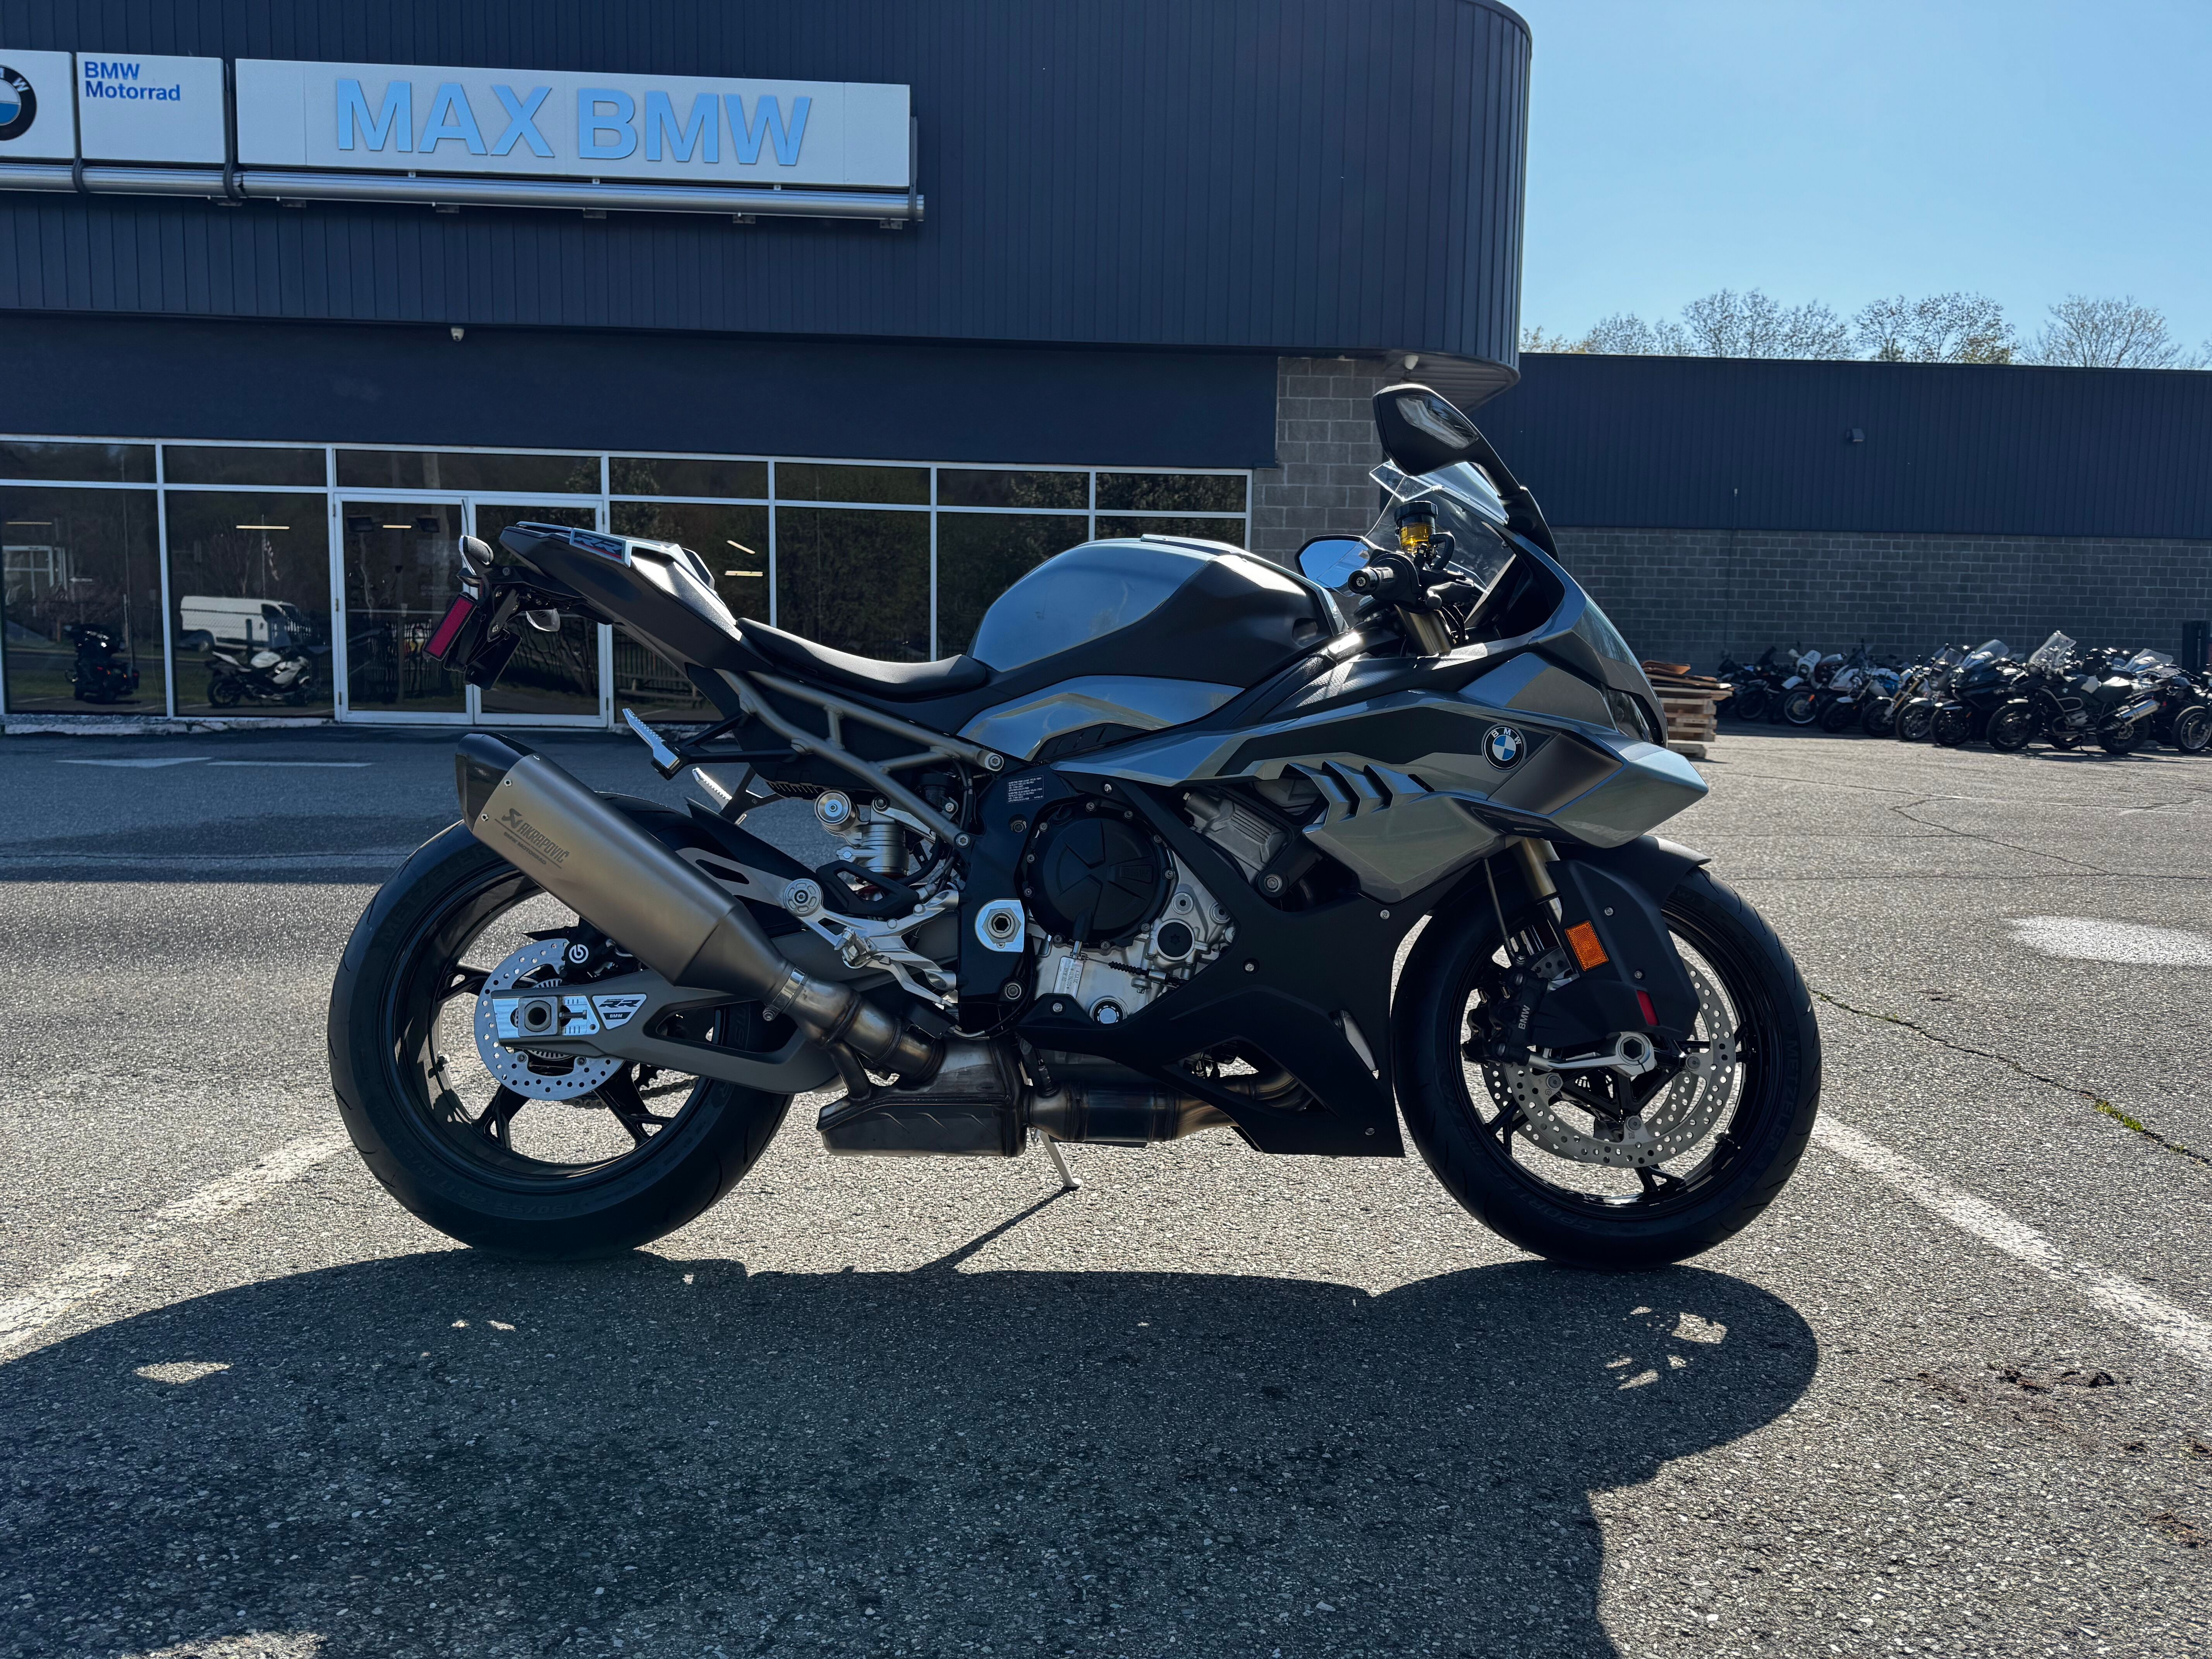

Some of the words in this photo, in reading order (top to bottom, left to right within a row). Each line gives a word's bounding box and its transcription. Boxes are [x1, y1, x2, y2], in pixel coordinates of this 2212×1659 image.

[84, 61, 140, 80] BMW
[86, 80, 180, 101] Motorrad
[337, 79, 555, 158] MAX
[578, 88, 812, 166] BMW
[574, 534, 622, 554] RR
[1491, 728, 1522, 744] BMW
[504, 831, 518, 843] BMW
[598, 999, 641, 1008] RR
[1518, 1005, 1530, 1030] BMW
[1767, 1040, 1799, 1151] METZELER
[1486, 1165, 1592, 1230] SPORTEC
